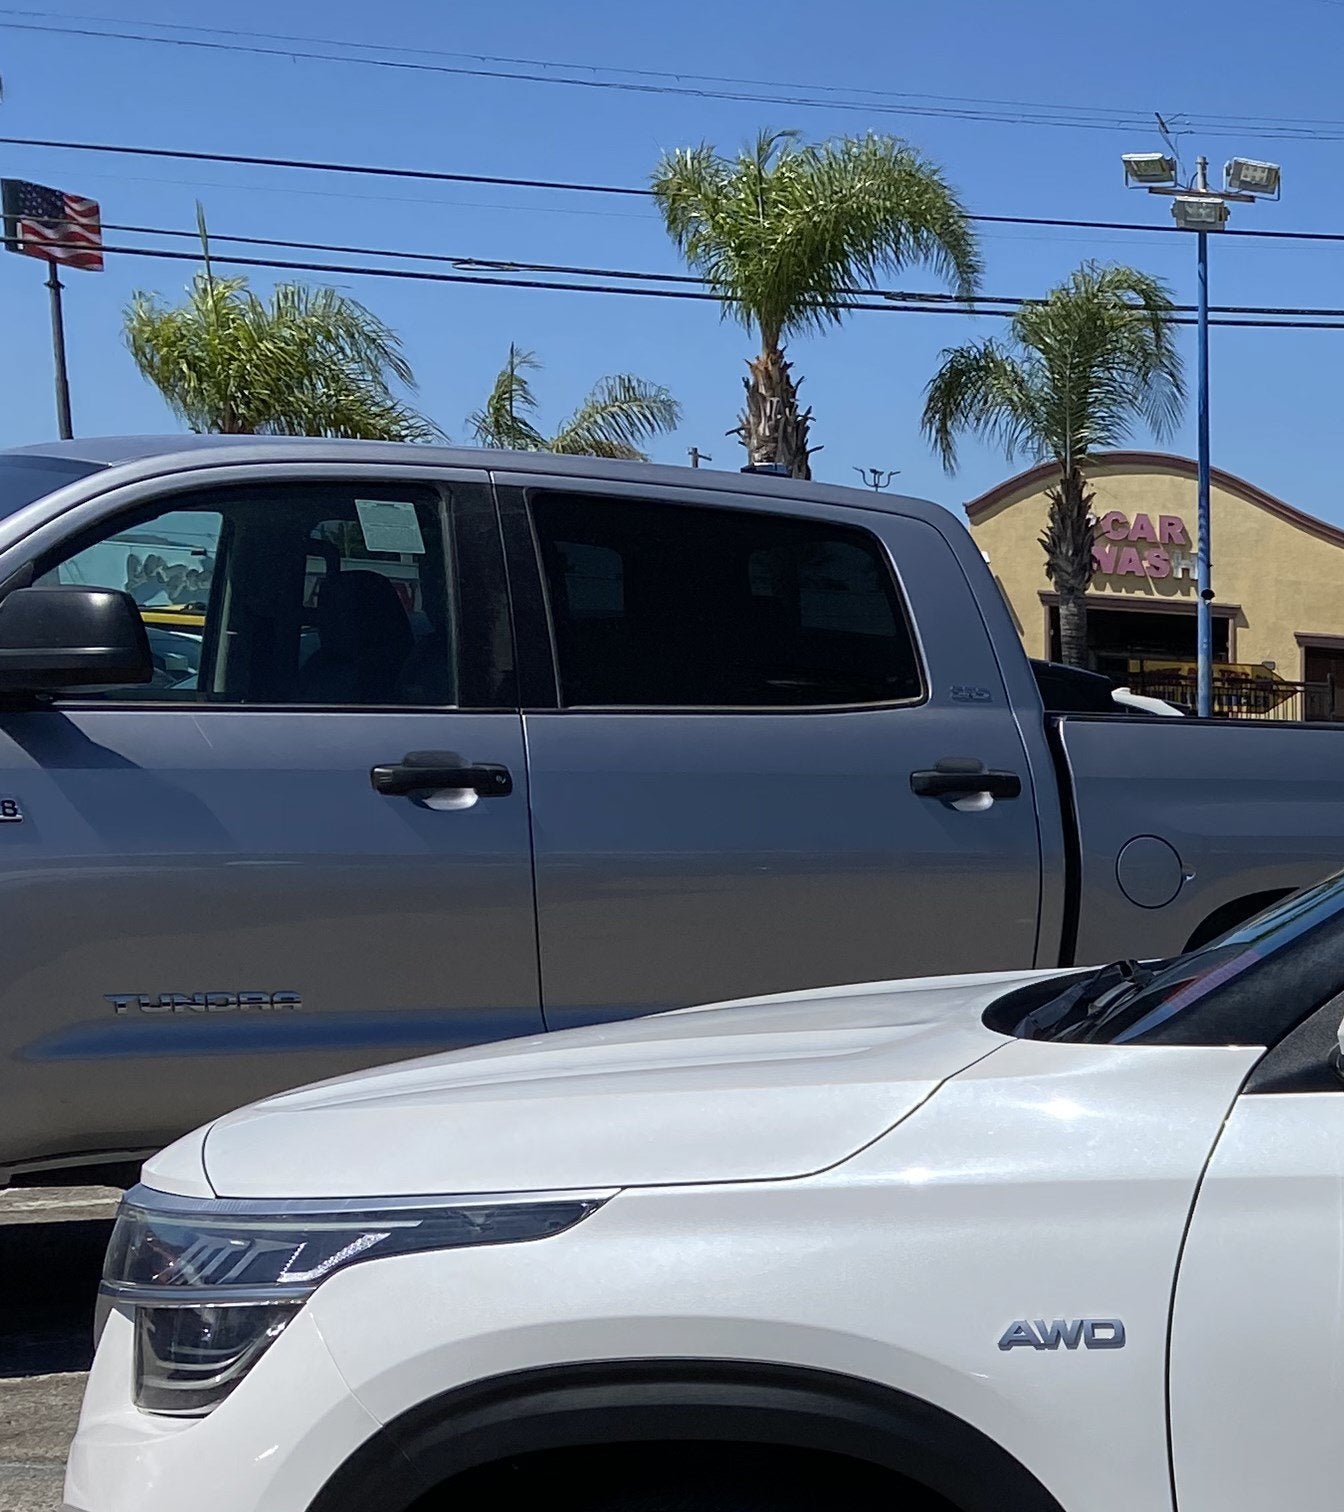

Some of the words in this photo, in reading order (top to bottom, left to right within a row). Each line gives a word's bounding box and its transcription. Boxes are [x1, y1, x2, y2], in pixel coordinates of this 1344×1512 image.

[1101, 511, 1186, 545] CAR
[103, 990, 302, 1014] TUNDRA
[998, 1319, 1126, 1351] AWD
